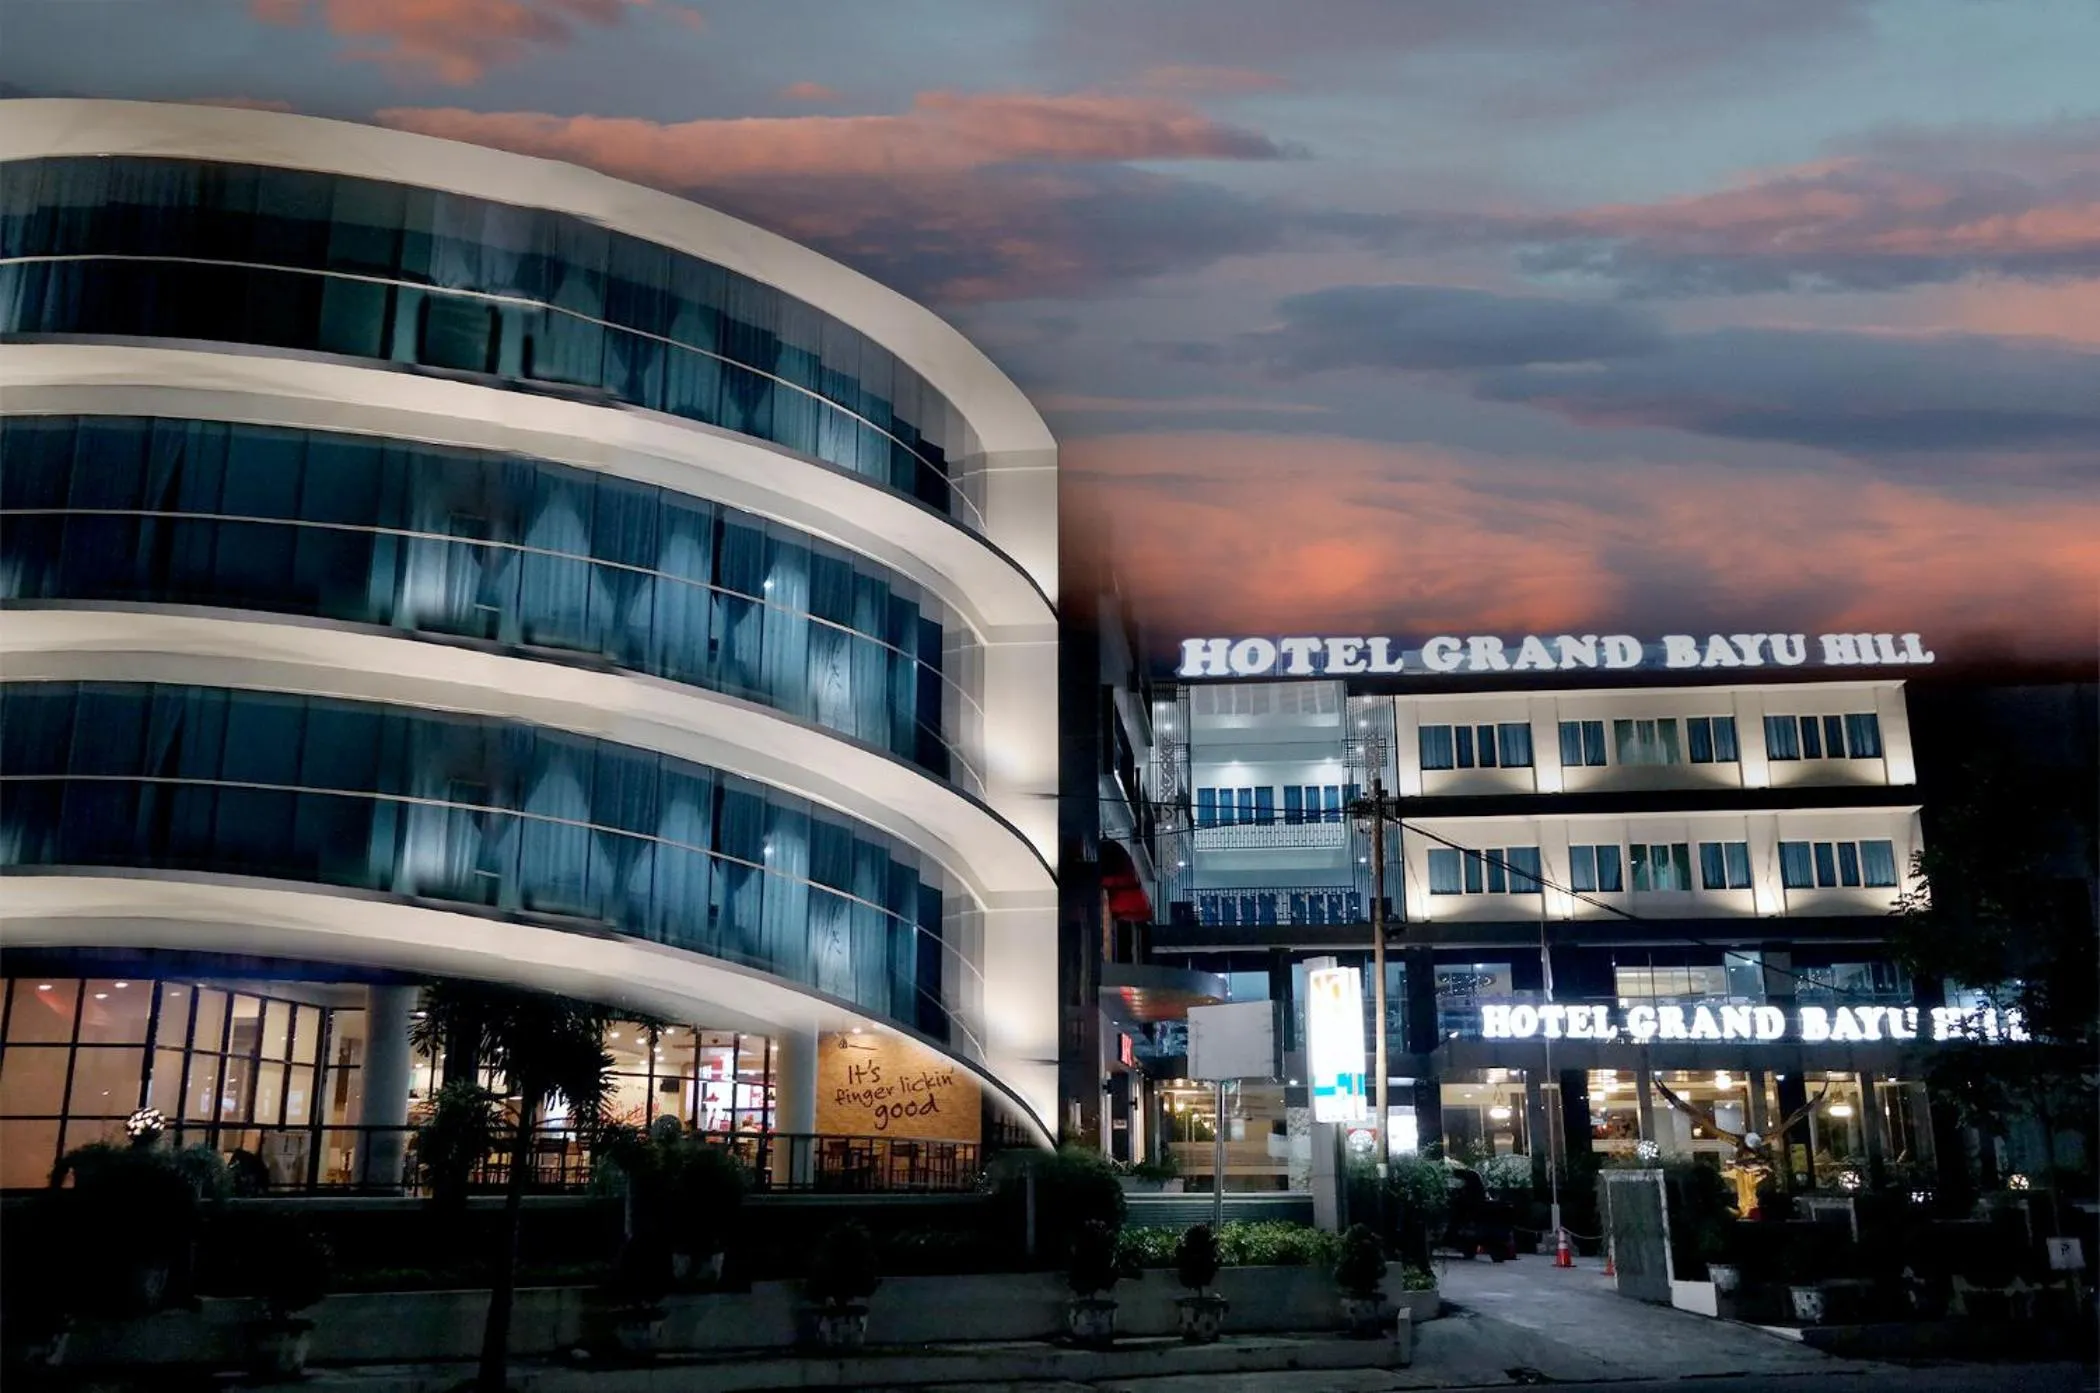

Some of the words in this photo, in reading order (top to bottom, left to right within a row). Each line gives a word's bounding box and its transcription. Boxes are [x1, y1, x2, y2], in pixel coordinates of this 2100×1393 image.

[1180, 637, 1403, 677] HOTEL
[1421, 634, 1643, 671] GRAND
[1662, 633, 1806, 668] BAYU
[1820, 632, 1936, 665] HILL
[1482, 1005, 1615, 1040] HOTEL
[1625, 1006, 1786, 1041] GRAND
[1801, 1006, 1919, 1041] BAYU
[835, 1085, 894, 1108] finger
[899, 1068, 955, 1094] lickin'
[848, 1059, 881, 1084] It's
[873, 1093, 940, 1130] good
